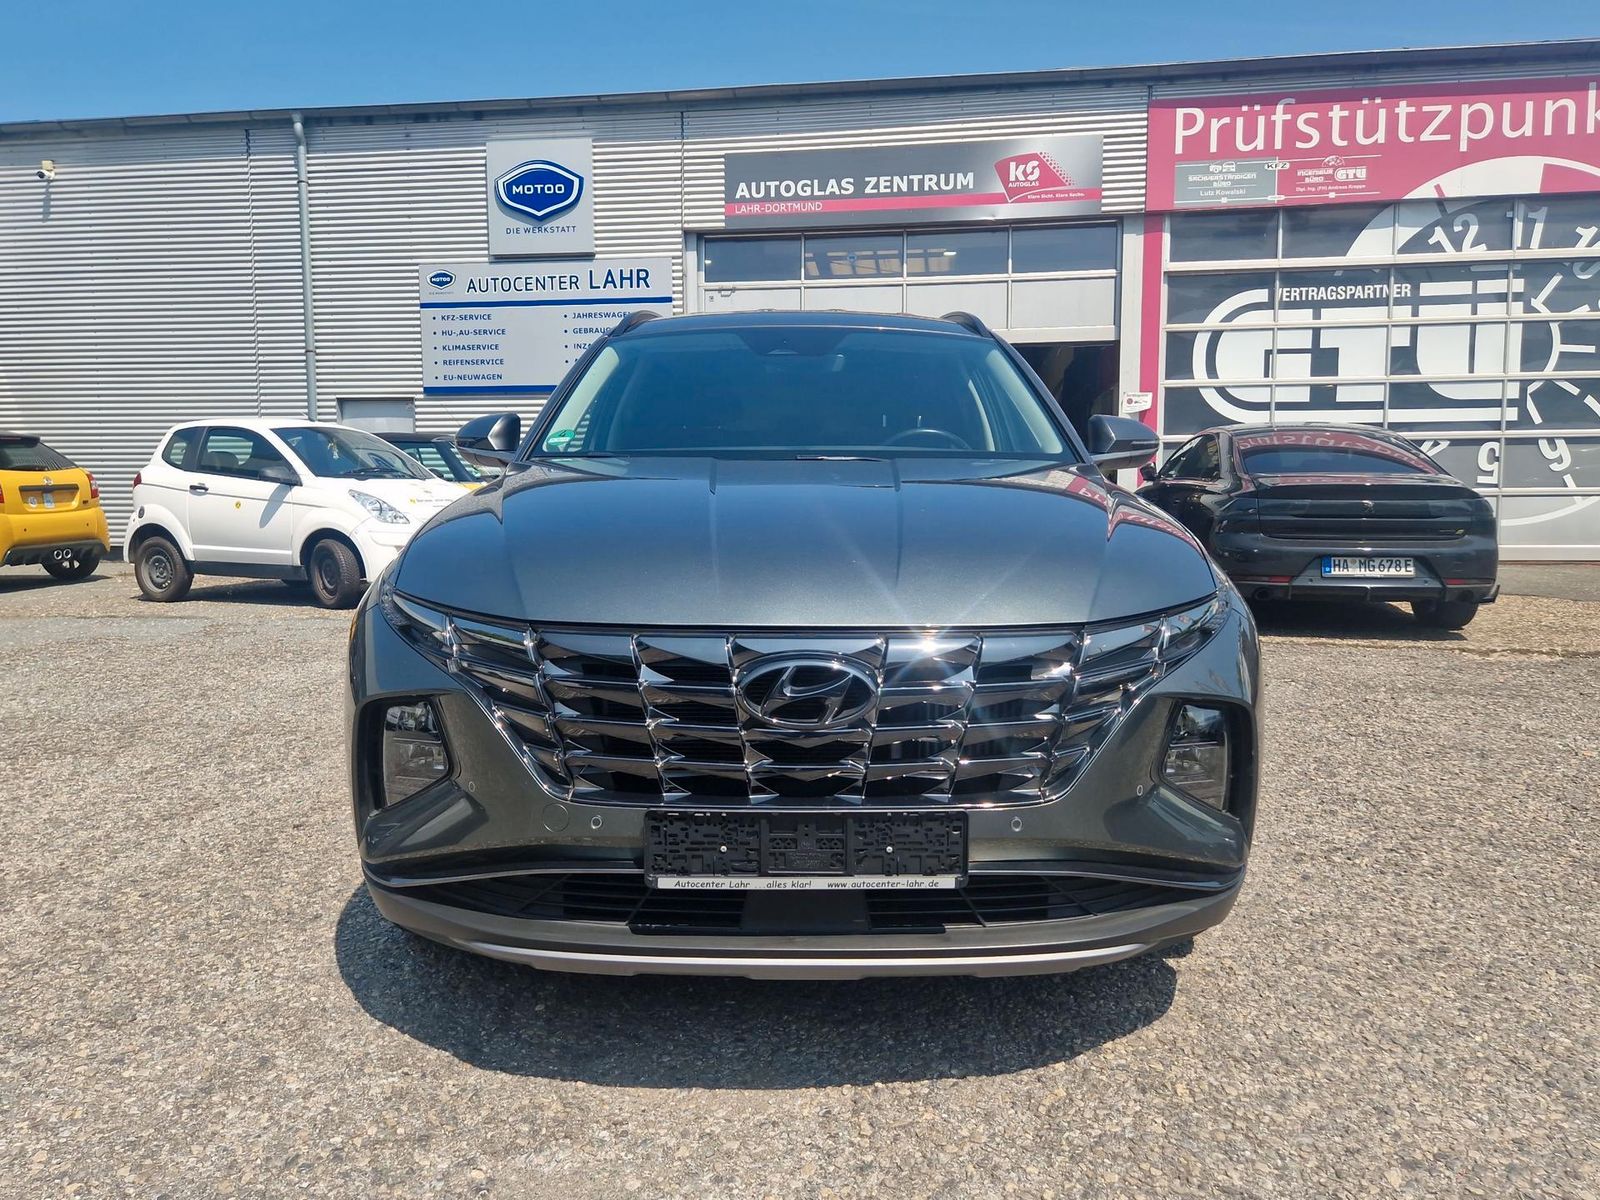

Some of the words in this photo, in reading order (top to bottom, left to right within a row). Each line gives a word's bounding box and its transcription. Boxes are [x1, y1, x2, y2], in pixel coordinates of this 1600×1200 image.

[512, 184, 565, 195] MOTOO
[735, 178, 855, 199] AUTOGLAS
[864, 172, 975, 194] ZENTRUM
[1216, 188, 1246, 196] Kowalski
[734, 202, 823, 214] LAHR-DORTMUND
[506, 227, 521, 235] DIE
[523, 225, 577, 234] WERKSTATT
[466, 275, 580, 294] AUTOCENTER
[588, 268, 651, 290] LAHR
[441, 313, 492, 321] KFZ-SERVICE
[572, 311, 631, 319] JAHRESWAGE
[442, 343, 500, 351] KLIMASERVICE
[442, 358, 505, 366] REIFENSERVICE
[443, 373, 503, 381] EU-NEUWAGEN
[1333, 559, 1349, 572] HA
[674, 880, 725, 888] Autocenter
[729, 880, 751, 888] Lahr
[827, 880, 940, 888] www.autocenter-lahr.de
